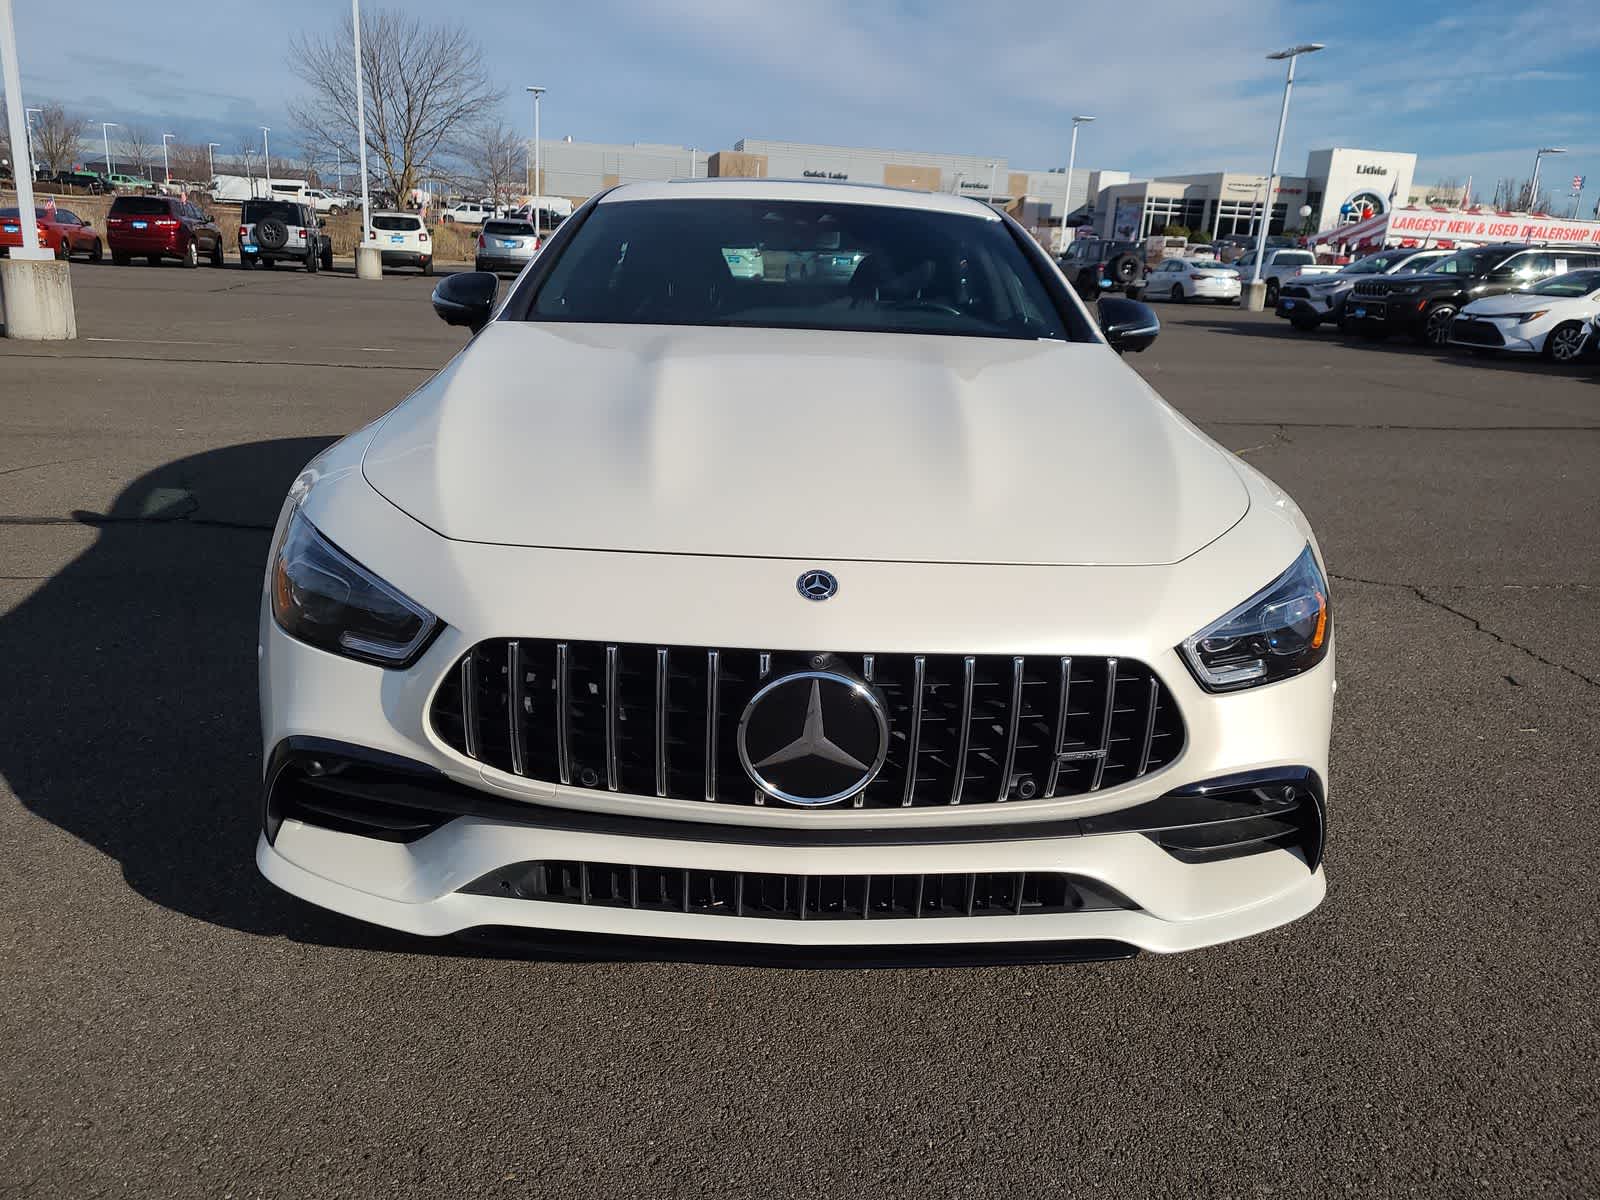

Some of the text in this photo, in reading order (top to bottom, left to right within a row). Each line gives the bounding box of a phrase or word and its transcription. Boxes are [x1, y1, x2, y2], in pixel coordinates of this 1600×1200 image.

[1356, 164, 1387, 176] Lithia
[1391, 216, 1446, 232] LARGEST
[1447, 220, 1474, 234] NEW
[1476, 222, 1485, 234] &
[1488, 222, 1518, 237] USED
[1521, 225, 1590, 240] DEALERSHIP
